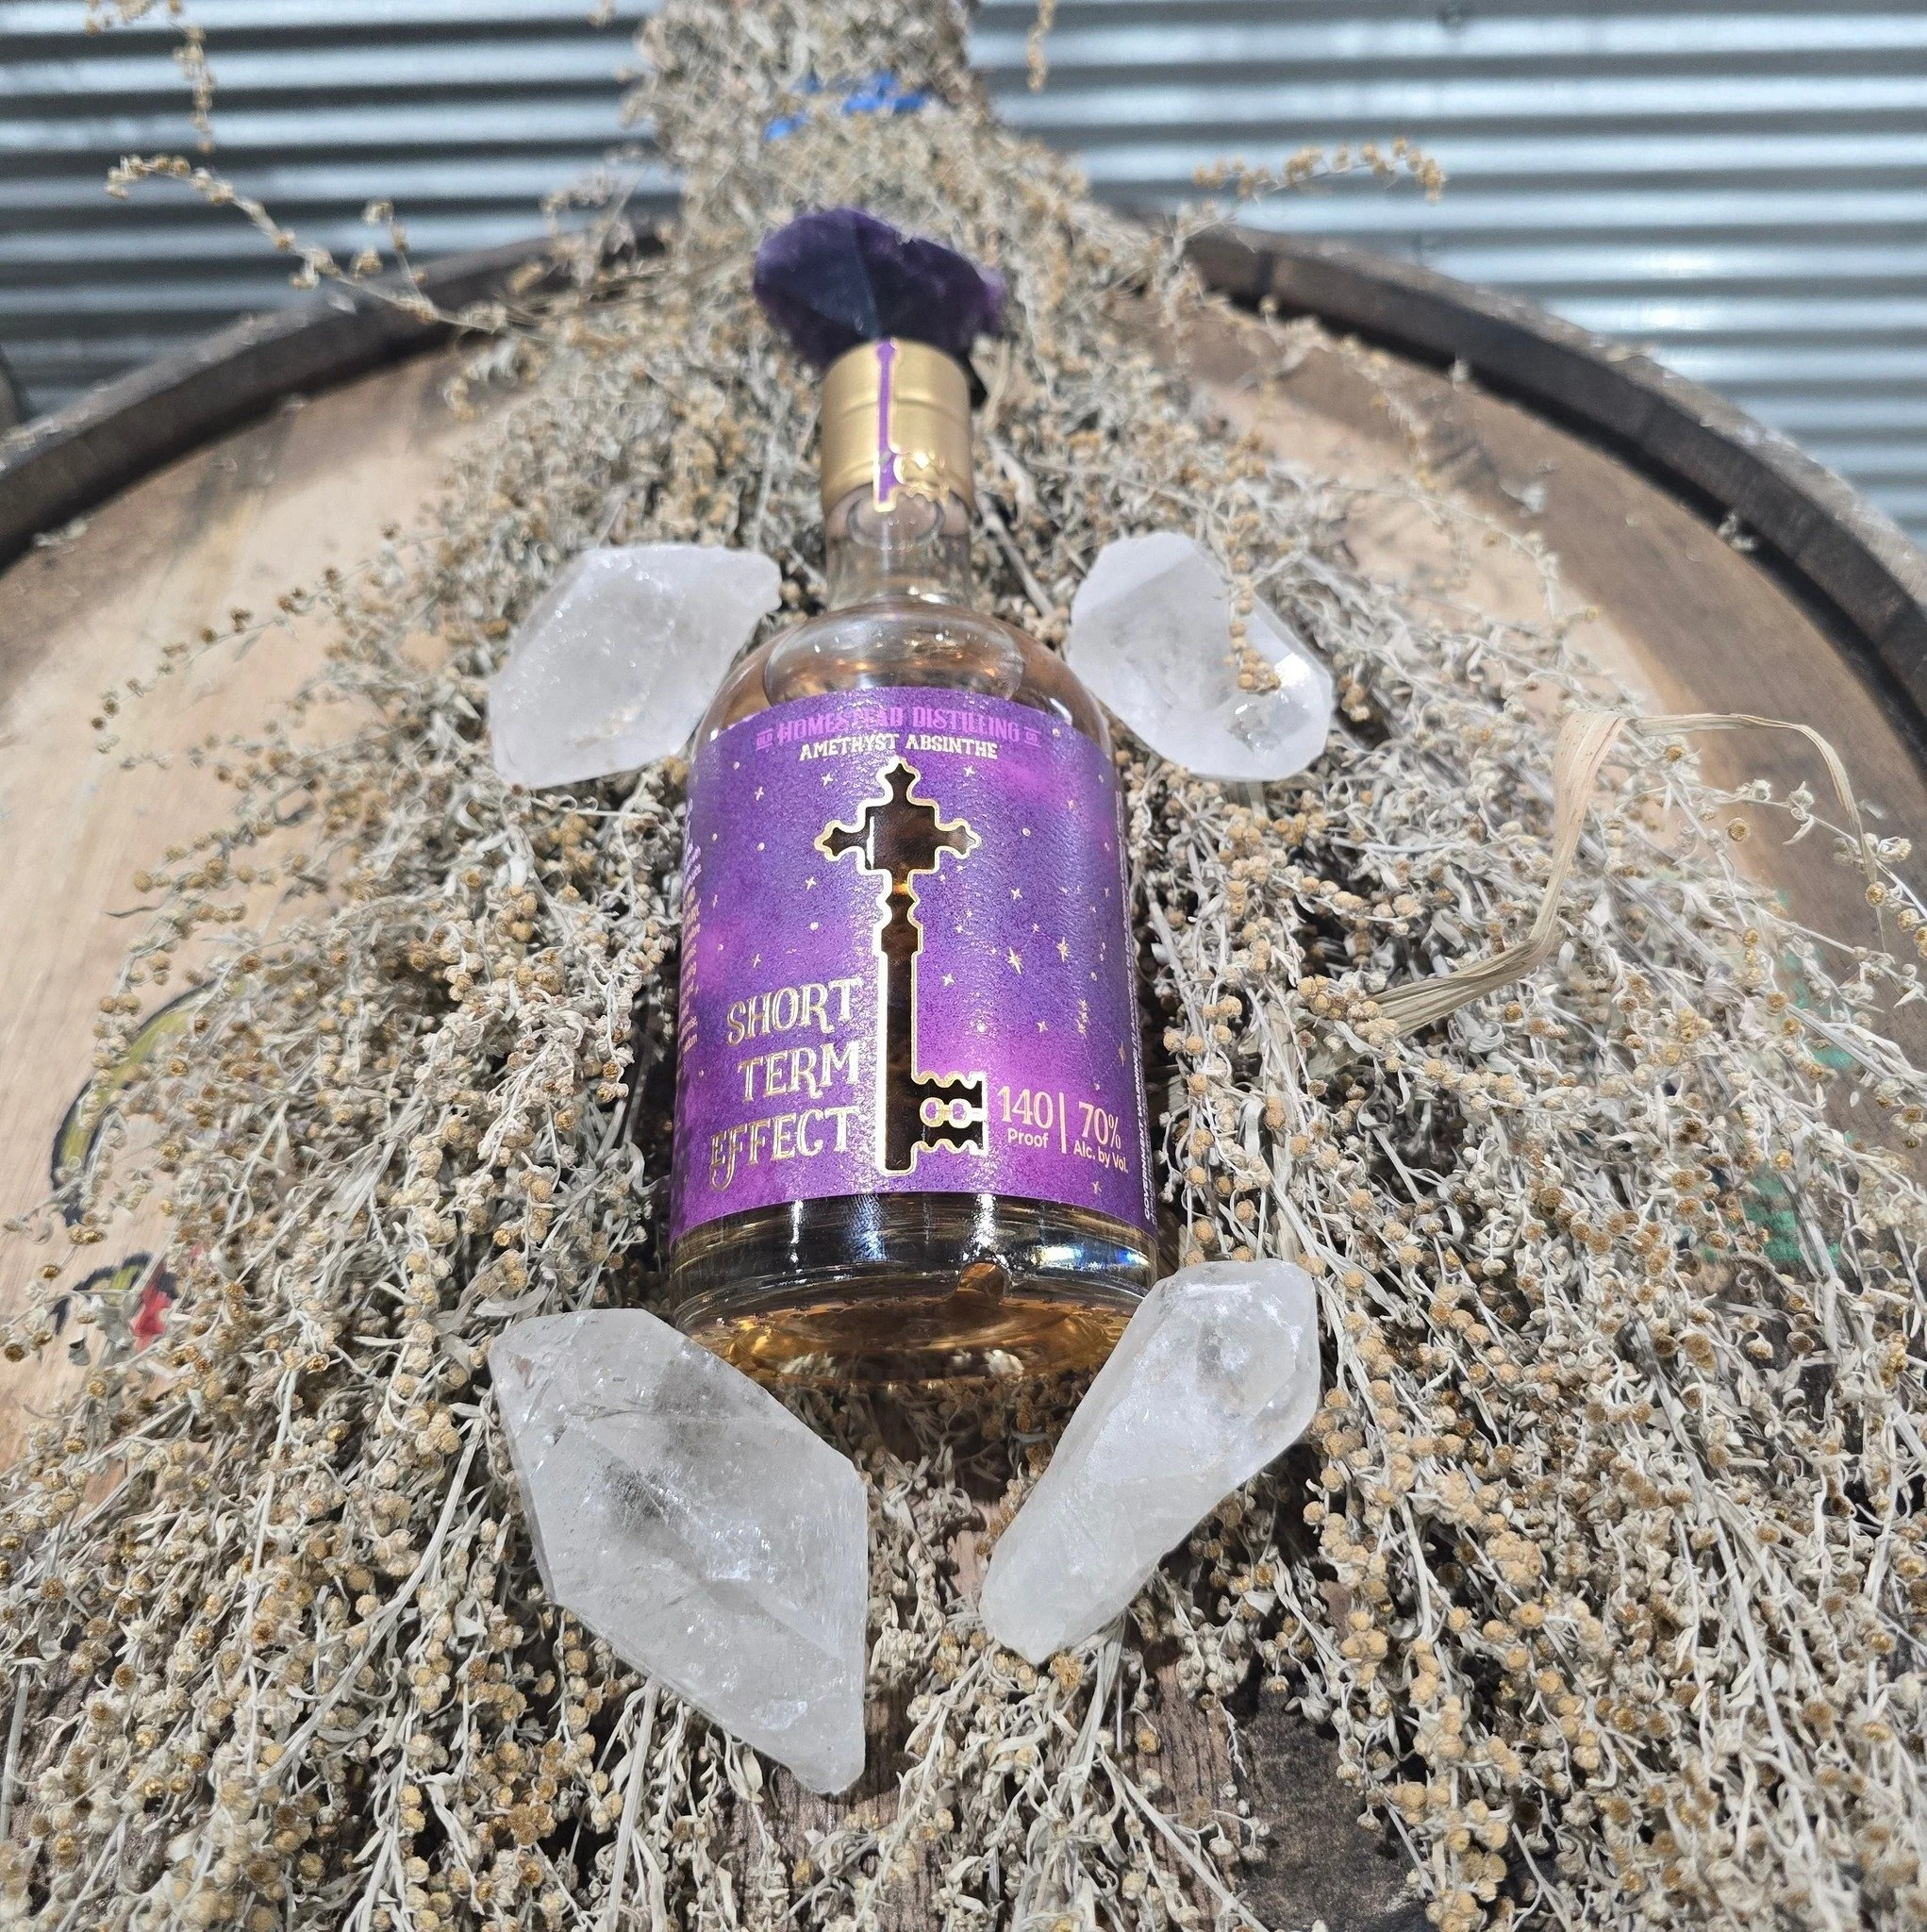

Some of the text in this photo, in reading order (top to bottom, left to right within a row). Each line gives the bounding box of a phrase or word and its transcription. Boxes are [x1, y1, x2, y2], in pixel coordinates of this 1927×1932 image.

[799, 733, 1000, 761] AMETHYST ABSINTHE
[912, 707, 1021, 742] DISTILLING
[725, 975, 865, 1047] SHORT
[737, 1041, 859, 1105] TERM
[998, 1084, 1054, 1130] 140
[1078, 1100, 1121, 1149] 70%
[708, 1103, 861, 1192] EFFECT
[1007, 1128, 1049, 1150] Proof
[1072, 1139, 1129, 1174] Alc. by Vol.
[1138, 1118, 1151, 1220] GOVERNMENT
